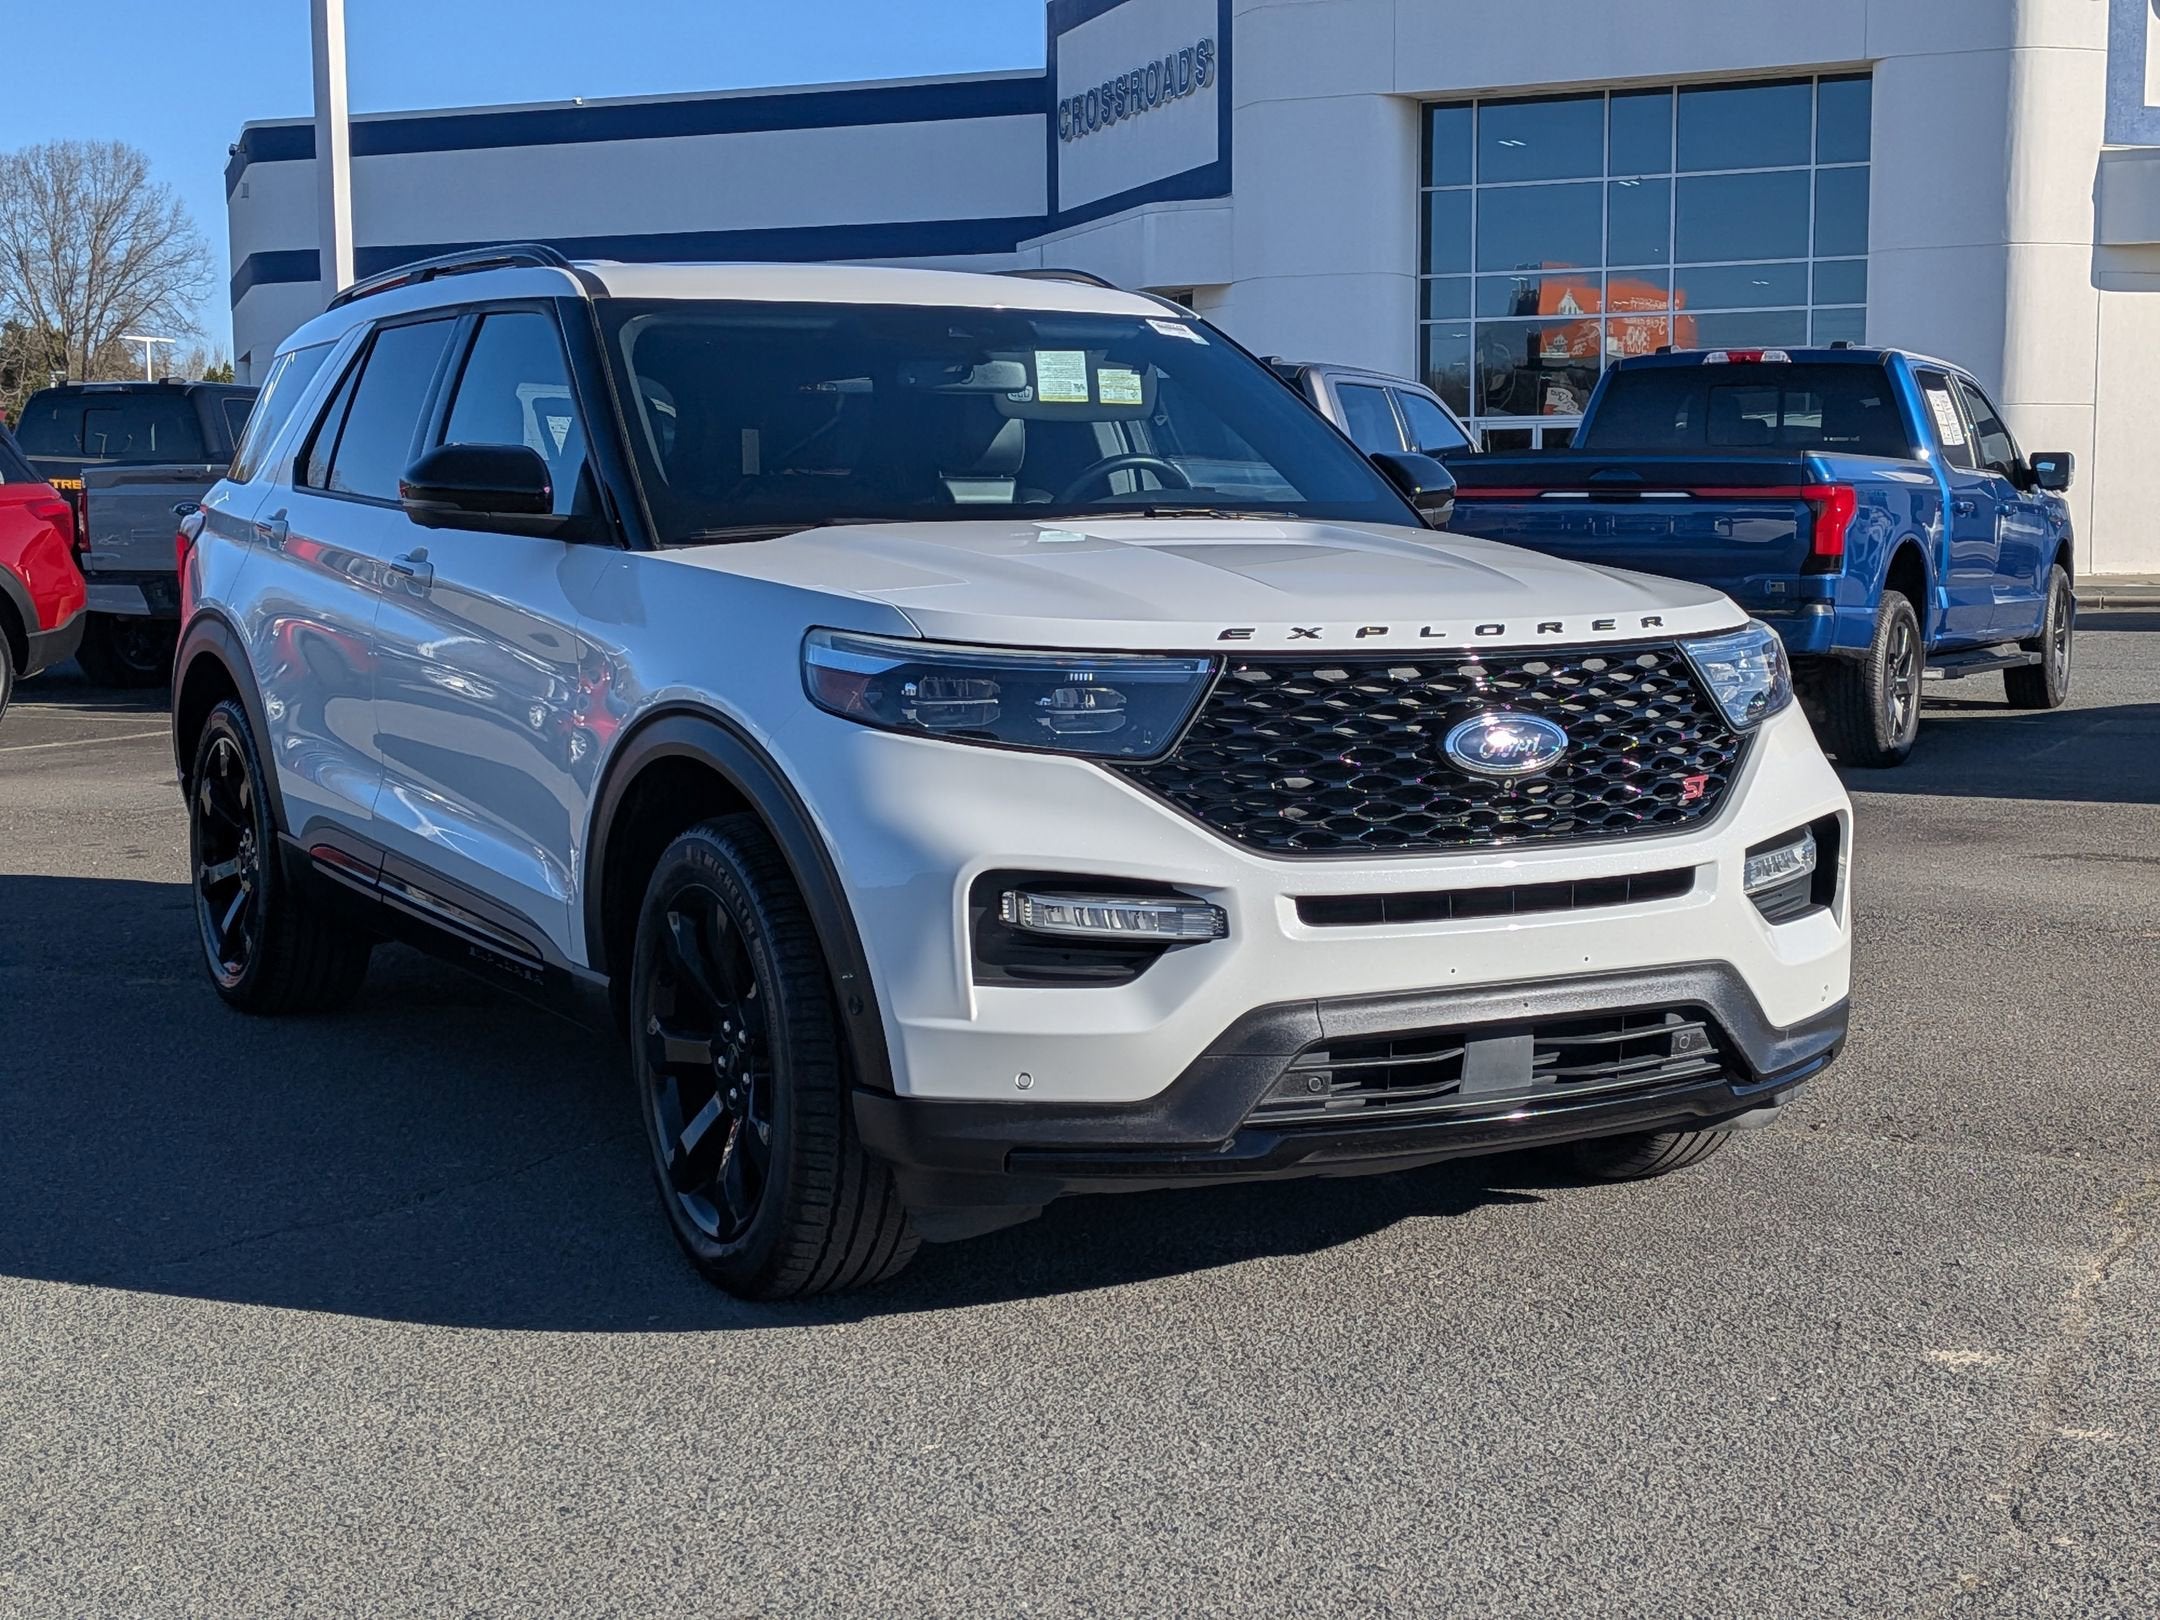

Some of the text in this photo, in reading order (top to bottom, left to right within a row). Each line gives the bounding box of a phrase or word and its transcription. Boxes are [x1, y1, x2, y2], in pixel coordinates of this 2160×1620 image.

[1057, 37, 1215, 142] CROSSROADS
[1216, 615, 1665, 641] EXPLORER
[1682, 774, 1709, 800] ST
